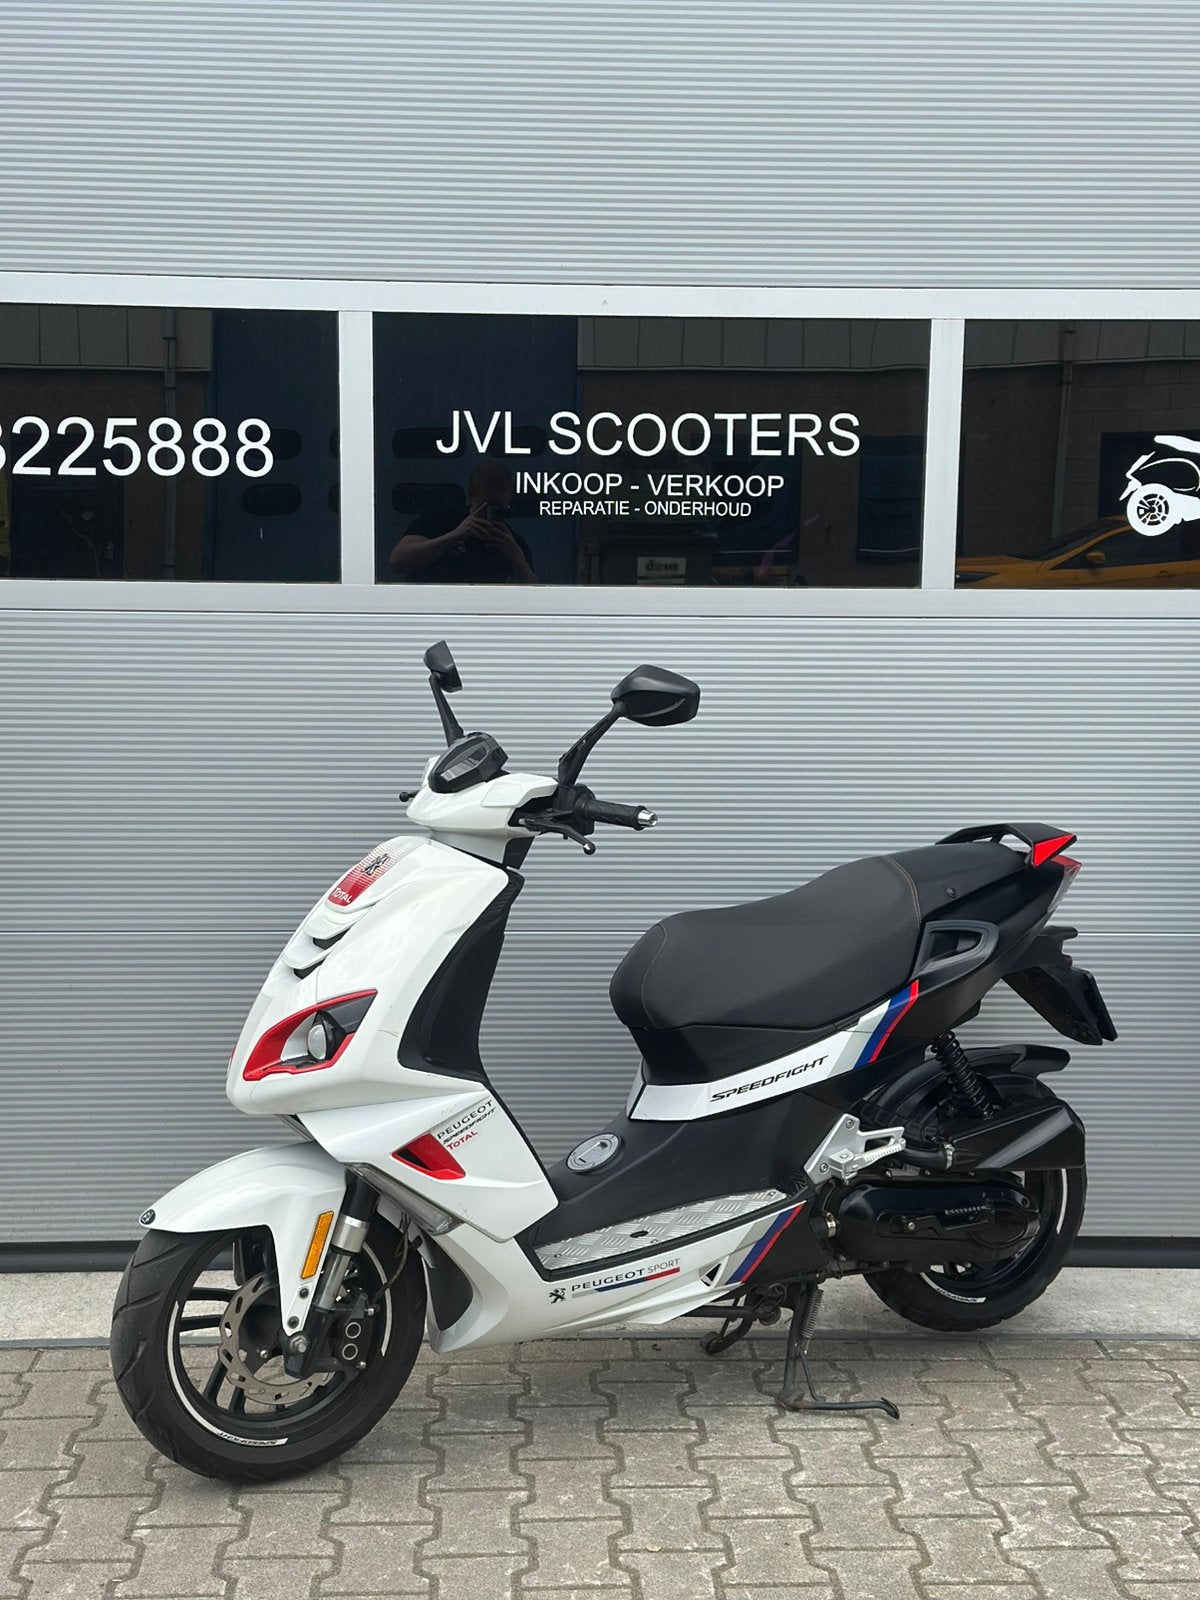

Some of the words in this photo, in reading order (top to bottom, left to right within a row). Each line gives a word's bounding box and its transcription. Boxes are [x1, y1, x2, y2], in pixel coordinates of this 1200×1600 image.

[0, 415, 274, 478] 225888
[436, 410, 531, 455] JVL
[548, 411, 860, 457] SCOOTERS
[515, 471, 623, 495] INKOOP
[647, 473, 785, 497] VERKOOP
[539, 500, 630, 516] REPARATIE
[644, 500, 752, 517] ONDERHOUD
[332, 888, 353, 903] TOTAL
[710, 1055, 828, 1102] SPEEDFIGHT
[437, 1100, 492, 1139] PEUGEOT
[446, 1131, 478, 1150] TOTAL
[571, 1269, 645, 1292] PEUGEOT
[647, 1258, 681, 1274] SPORT
